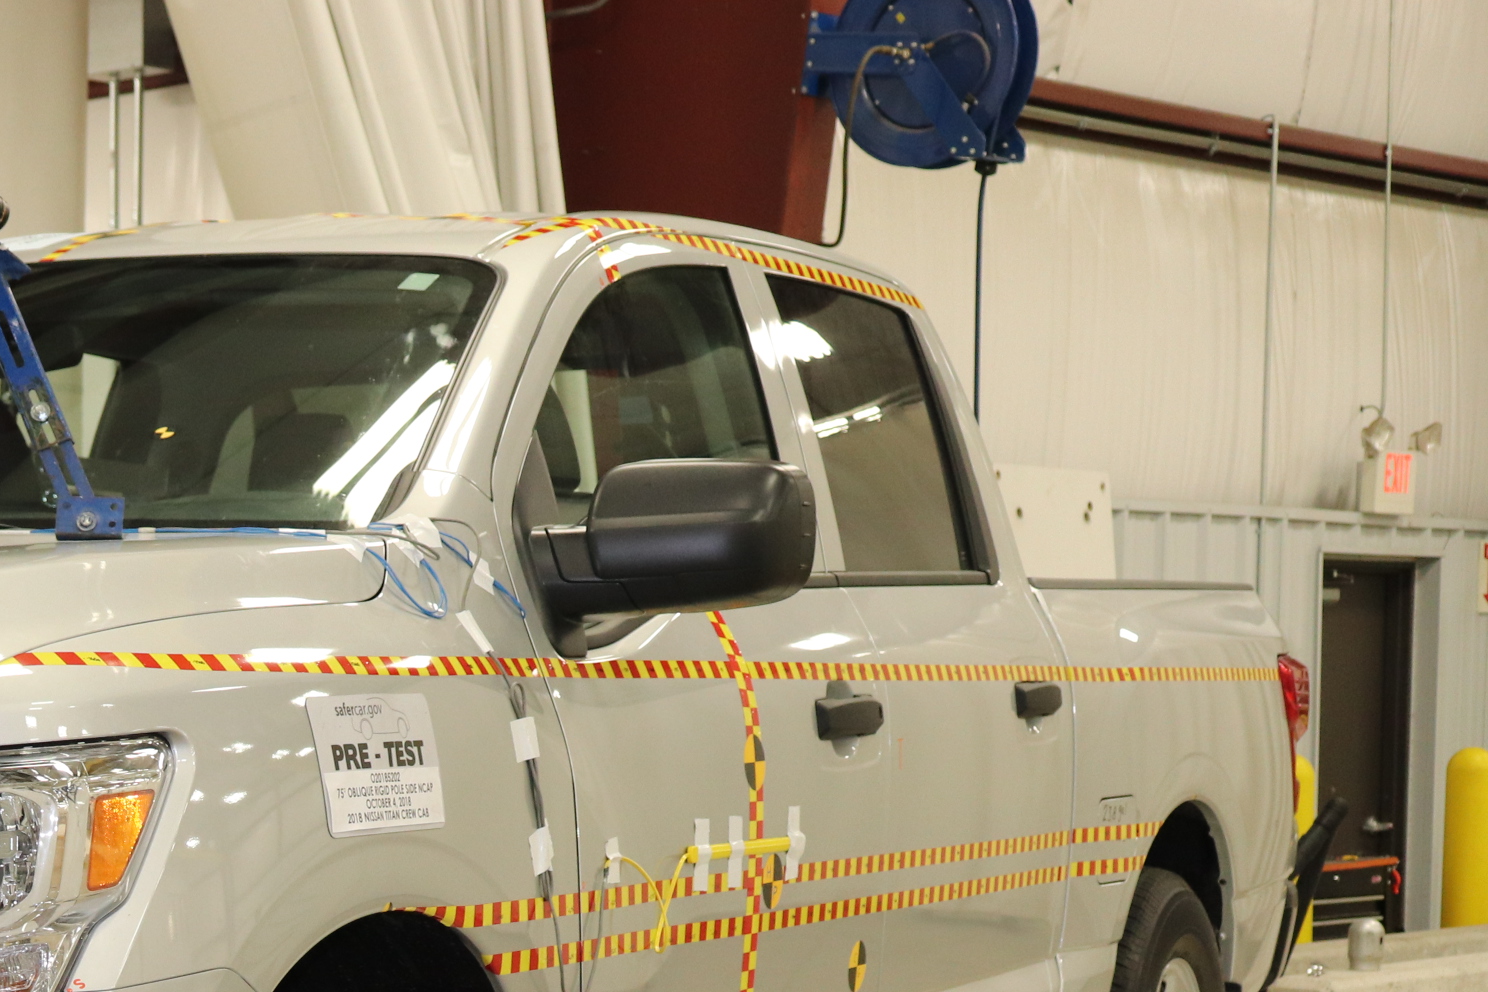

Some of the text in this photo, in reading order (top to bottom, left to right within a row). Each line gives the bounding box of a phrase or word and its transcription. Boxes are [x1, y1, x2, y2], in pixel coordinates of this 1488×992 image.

[334, 702, 383, 718] safercar.gov
[331, 742, 372, 771] PRE
[383, 740, 424, 767] TEST
[347, 786, 374, 798] OBLIQUE
[375, 785, 390, 796] RIGID
[391, 784, 405, 795] POLE
[406, 783, 418, 794] SIDE
[418, 782, 433, 793] NCAP
[366, 797, 392, 809] OCTOBER
[399, 796, 412, 807] 2018
[348, 807, 430, 824] 2018 NISSAN TITAN CREW CAB
